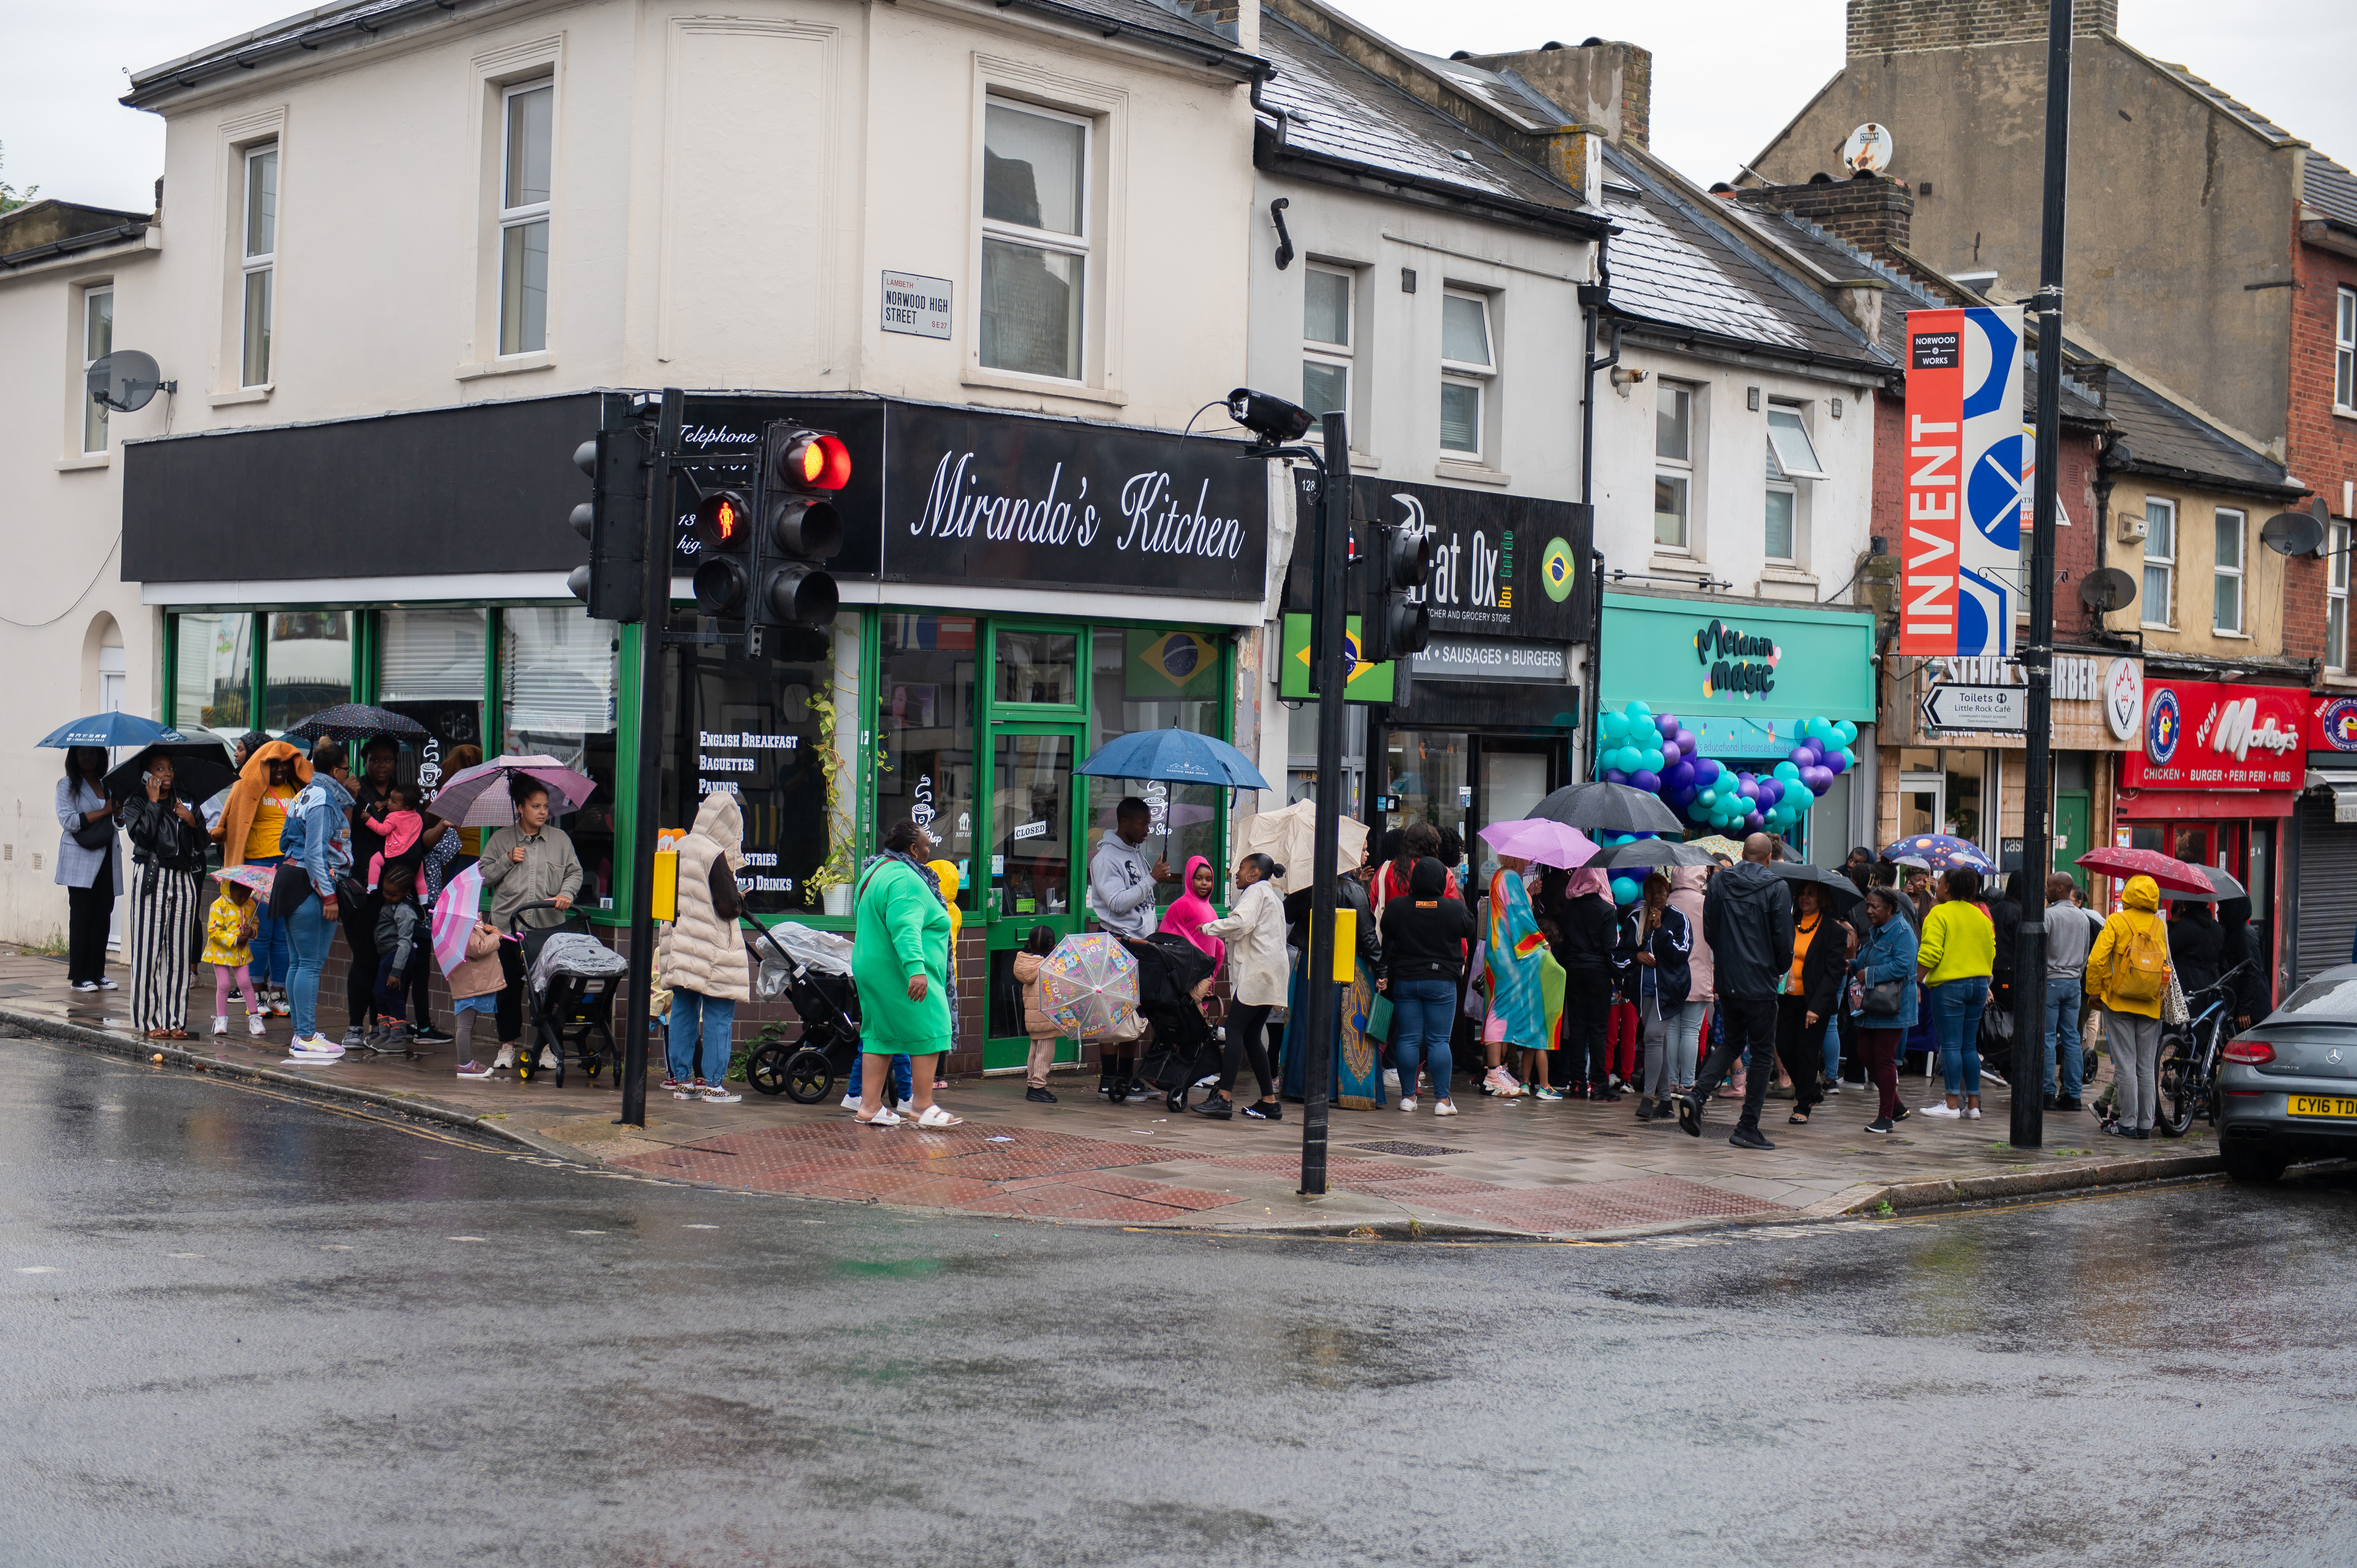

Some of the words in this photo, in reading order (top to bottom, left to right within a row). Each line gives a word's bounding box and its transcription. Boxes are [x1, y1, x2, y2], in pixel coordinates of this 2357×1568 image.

[887, 279, 913, 289] LAMBETH
[886, 290, 925, 309] NORWOOD
[929, 297, 947, 313] HIGH
[886, 307, 917, 324] STREET
[1915, 336, 1956, 345] NORWOOD
[1922, 357, 1948, 365] WORKS
[680, 425, 758, 449] Telephone
[1302, 480, 1316, 491] 128
[910, 450, 1100, 547] Miranda's
[1117, 470, 1246, 559] Kitchen
[678, 514, 696, 526] 13
[1907, 414, 1957, 635] INVENT
[677, 534, 701, 554] hig
[1500, 530, 1513, 577] Gordo
[1471, 530, 1498, 607] Ox
[1427, 608, 1446, 619] TCHER
[1448, 610, 1460, 619] AND
[1462, 611, 1490, 621] GROCERY
[1491, 613, 1511, 623] STORE
[1698, 619, 1774, 665] Melanin
[1412, 645, 1431, 661] RK
[1442, 646, 1502, 664] SAUSAGES
[1512, 650, 1562, 667] BURGERS
[1948, 657, 2028, 690] STEVENS
[2051, 657, 2097, 700] ARBER
[1959, 693, 1993, 702] Toilets
[2152, 691, 2168, 717] MORLEY'S
[2168, 692, 2179, 717] CHICKEN
[2314, 699, 2329, 718] New
[2327, 699, 2352, 717] MORLEY'S
[2196, 701, 2217, 747] New
[2213, 697, 2299, 762] Morley's
[742, 732, 798, 748] BREAKFAST
[1704, 740, 1739, 752] educational
[1742, 743, 1771, 754] resources,
[1774, 742, 1790, 754] books
[2327, 731, 2350, 749] MORLEY'S
[2151, 738, 2164, 763] MORLEY'S
[2164, 737, 2177, 762] CHICKEN
[699, 754, 754, 771] BAGUETTES
[2144, 768, 2180, 780] CHICKEN
[2190, 769, 2223, 782] BURGER
[2229, 770, 2247, 782] PERI
[2249, 770, 2266, 782] PERI
[2273, 770, 2291, 782] RIBS
[263, 796, 277, 806] hair
[1016, 825, 1045, 837] CLOSED
[2005, 839, 2023, 852] cas
[742, 853, 777, 866] STRIES
[756, 875, 792, 891] DRINKS
[1080, 936, 1101, 948] PUPS
[1086, 944, 1104, 955] TOP
[1042, 979, 1054, 1002] PUPS
[1051, 979, 1062, 999] TOP
[1084, 1023, 1103, 1032] TOP
[2297, 1098, 2330, 1113] CY16
